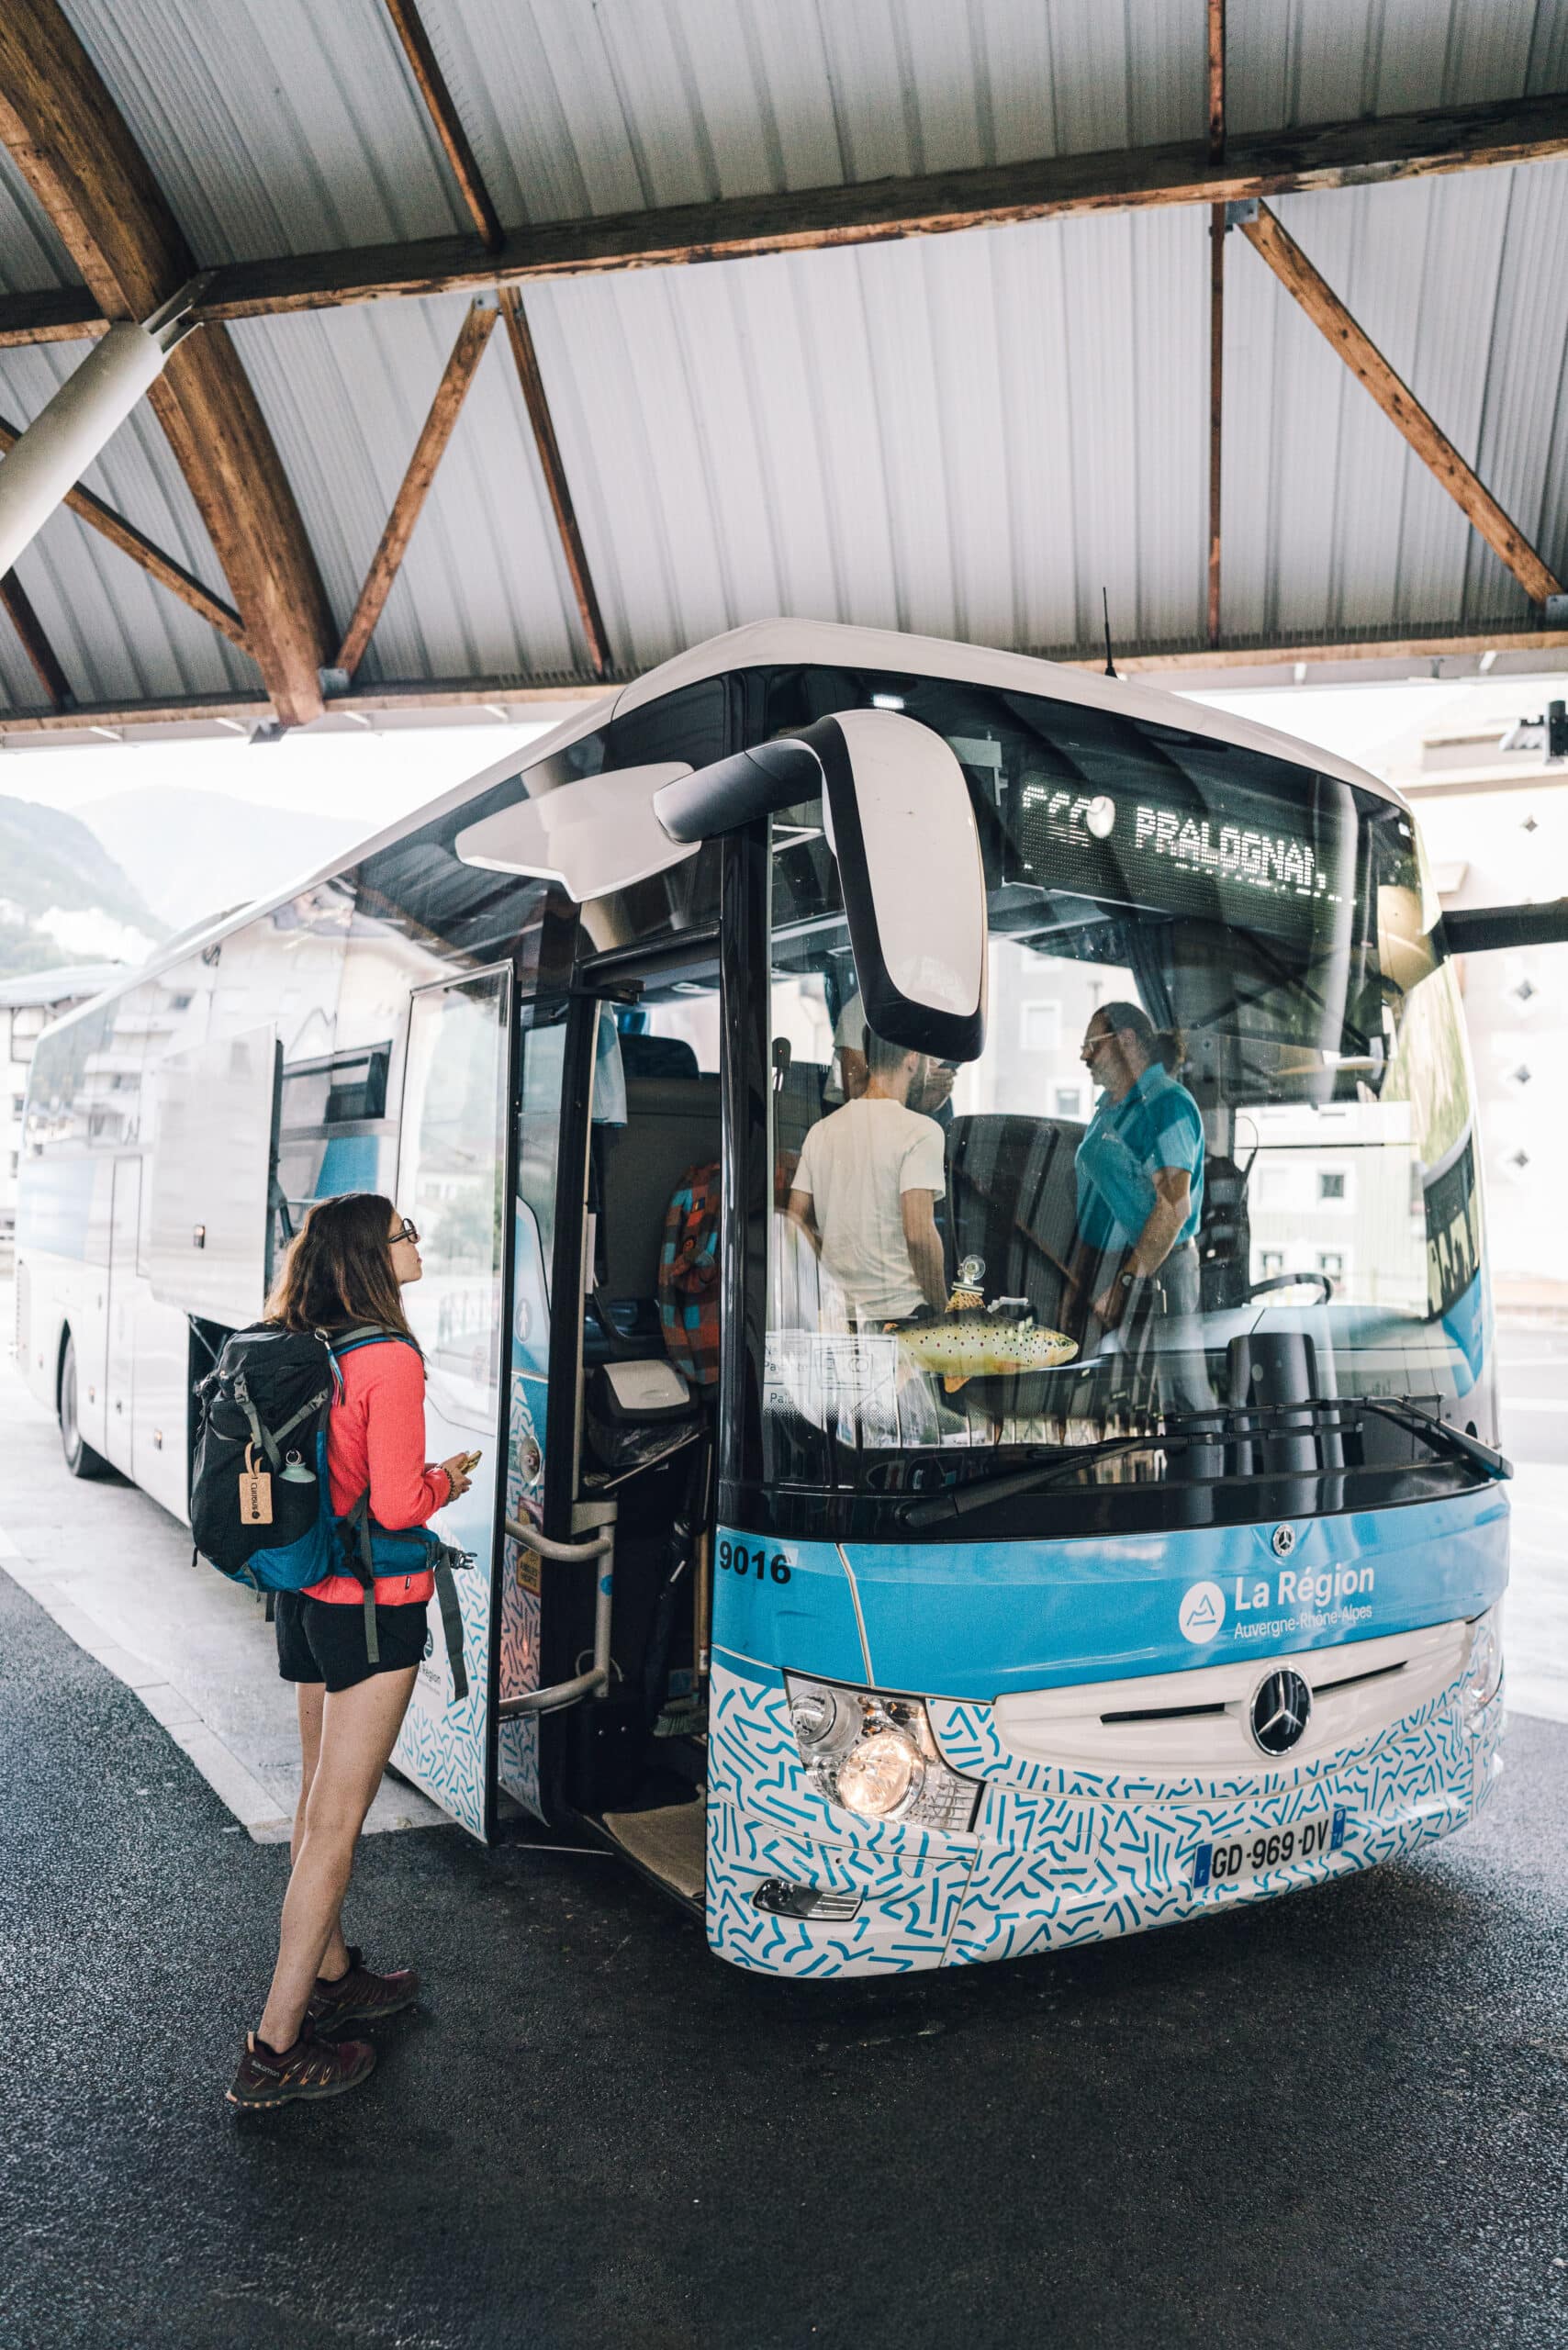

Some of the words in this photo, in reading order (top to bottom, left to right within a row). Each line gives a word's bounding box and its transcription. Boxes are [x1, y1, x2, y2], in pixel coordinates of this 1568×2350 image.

[720, 1541, 791, 1584] 9016
[1235, 1577, 1270, 1611] La
[1278, 1563, 1374, 1606] Région
[1234, 1604, 1372, 1639] Auvergne-Rhône-Alpes
